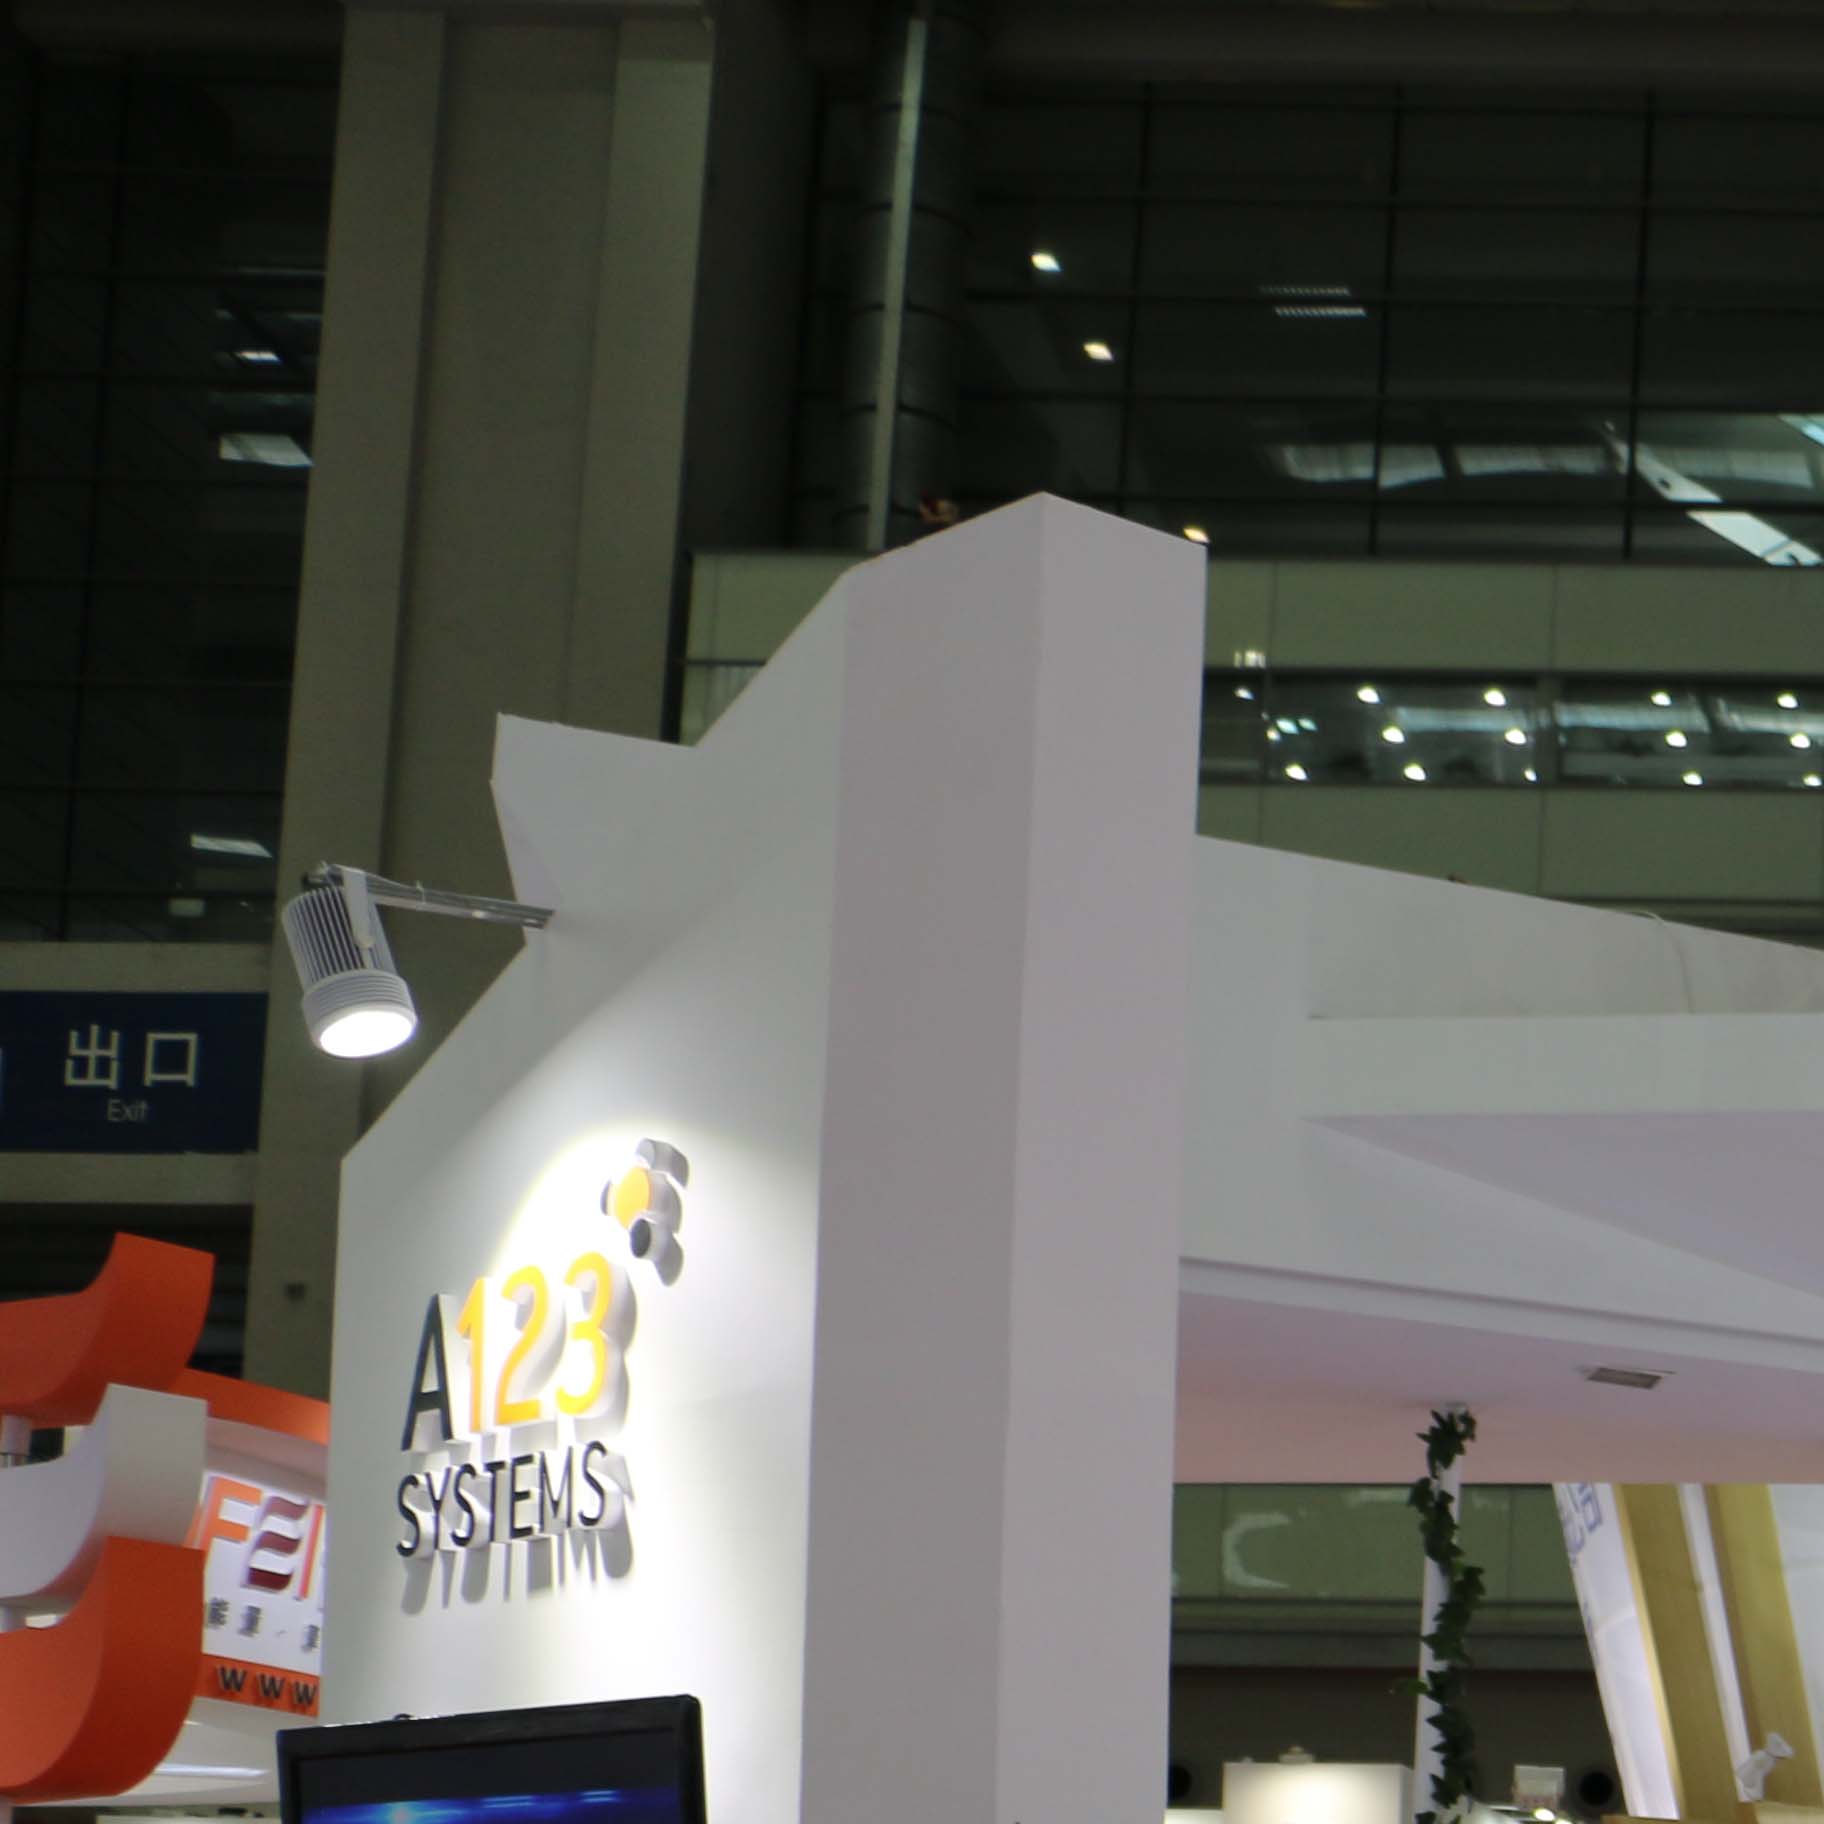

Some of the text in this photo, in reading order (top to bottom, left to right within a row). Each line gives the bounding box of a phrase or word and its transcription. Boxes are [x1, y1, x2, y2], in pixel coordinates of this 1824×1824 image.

[64, 1021, 199, 1089] 出口
[106, 1098, 148, 1122] Exit
[402, 1252, 613, 1451] A123
[396, 1440, 608, 1558] SYSTEMS
